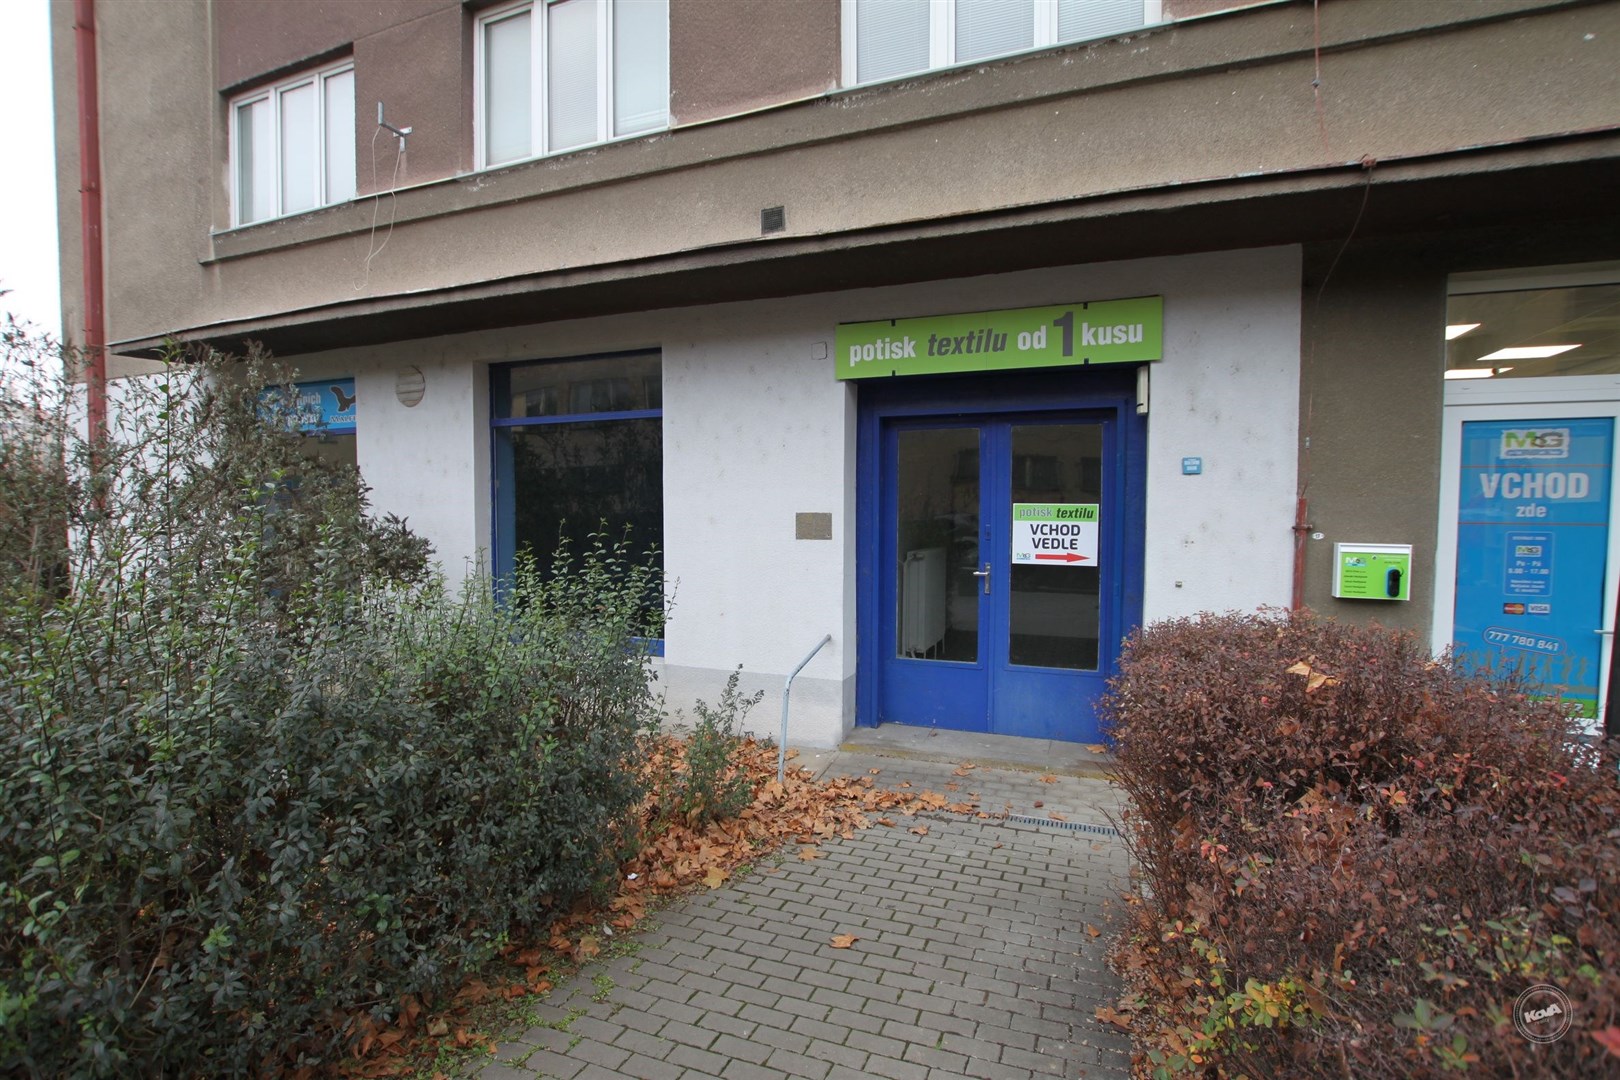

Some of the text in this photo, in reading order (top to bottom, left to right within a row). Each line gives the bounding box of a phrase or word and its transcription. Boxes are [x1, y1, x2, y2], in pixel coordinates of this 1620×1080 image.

[850, 311, 1143, 367] potisk textilu od 1 kusu
[1480, 472, 1589, 499] VCHOD
[1019, 507, 1094, 519] potisk textilu
[1515, 503, 1547, 518] zde
[1030, 523, 1081, 536] VCHOD
[1032, 537, 1079, 550] VEDLE
[1488, 630, 1559, 652] 777 780 841
